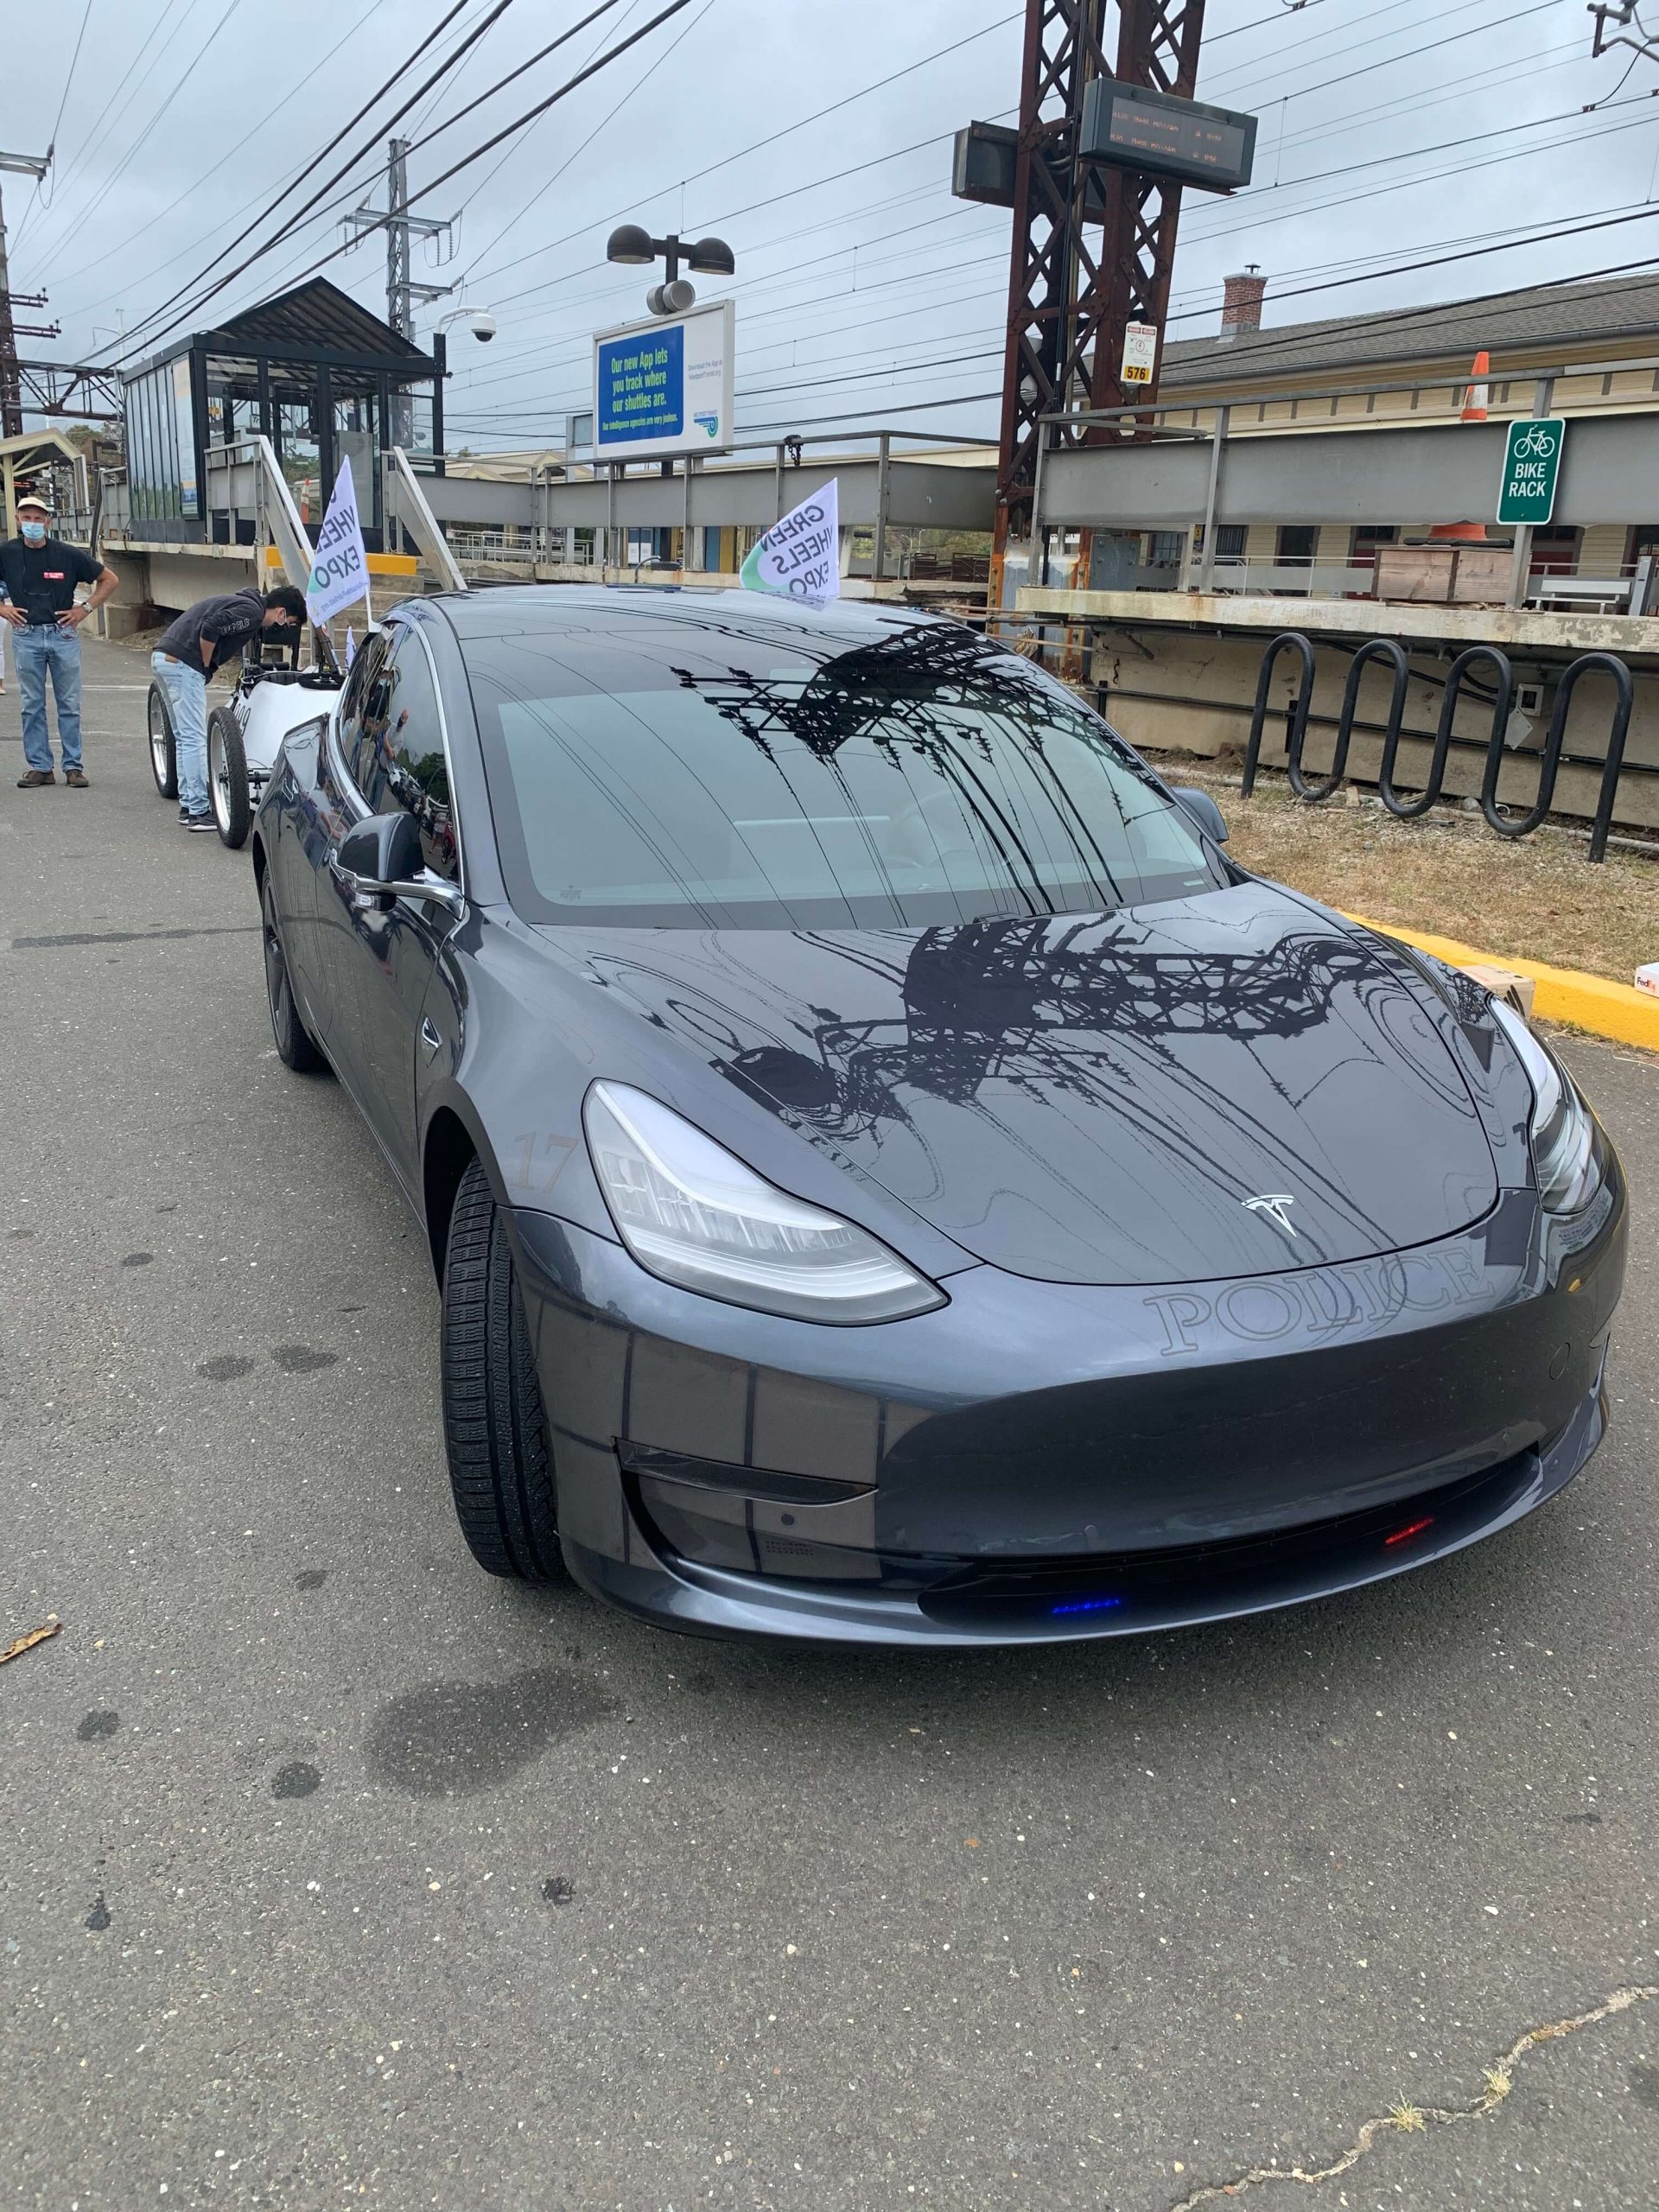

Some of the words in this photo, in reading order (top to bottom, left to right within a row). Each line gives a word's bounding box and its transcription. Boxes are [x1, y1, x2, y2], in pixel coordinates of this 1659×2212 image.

[612, 357, 622, 373] Our
[624, 356, 638, 371] new
[639, 351, 653, 371] App
[655, 347, 668, 365] lets
[613, 379, 624, 397] you
[626, 372, 643, 391] track
[645, 371, 666, 387] where
[1127, 366, 1146, 380] 576
[613, 399, 623, 413] our
[625, 392, 652, 410] shuttles
[653, 392, 667, 406] are.
[1515, 462, 1547, 479] BIKE
[1509, 481, 1547, 497] RACK
[512, 1131, 580, 1193] 17
[1143, 1247, 1495, 1357] POLICE
